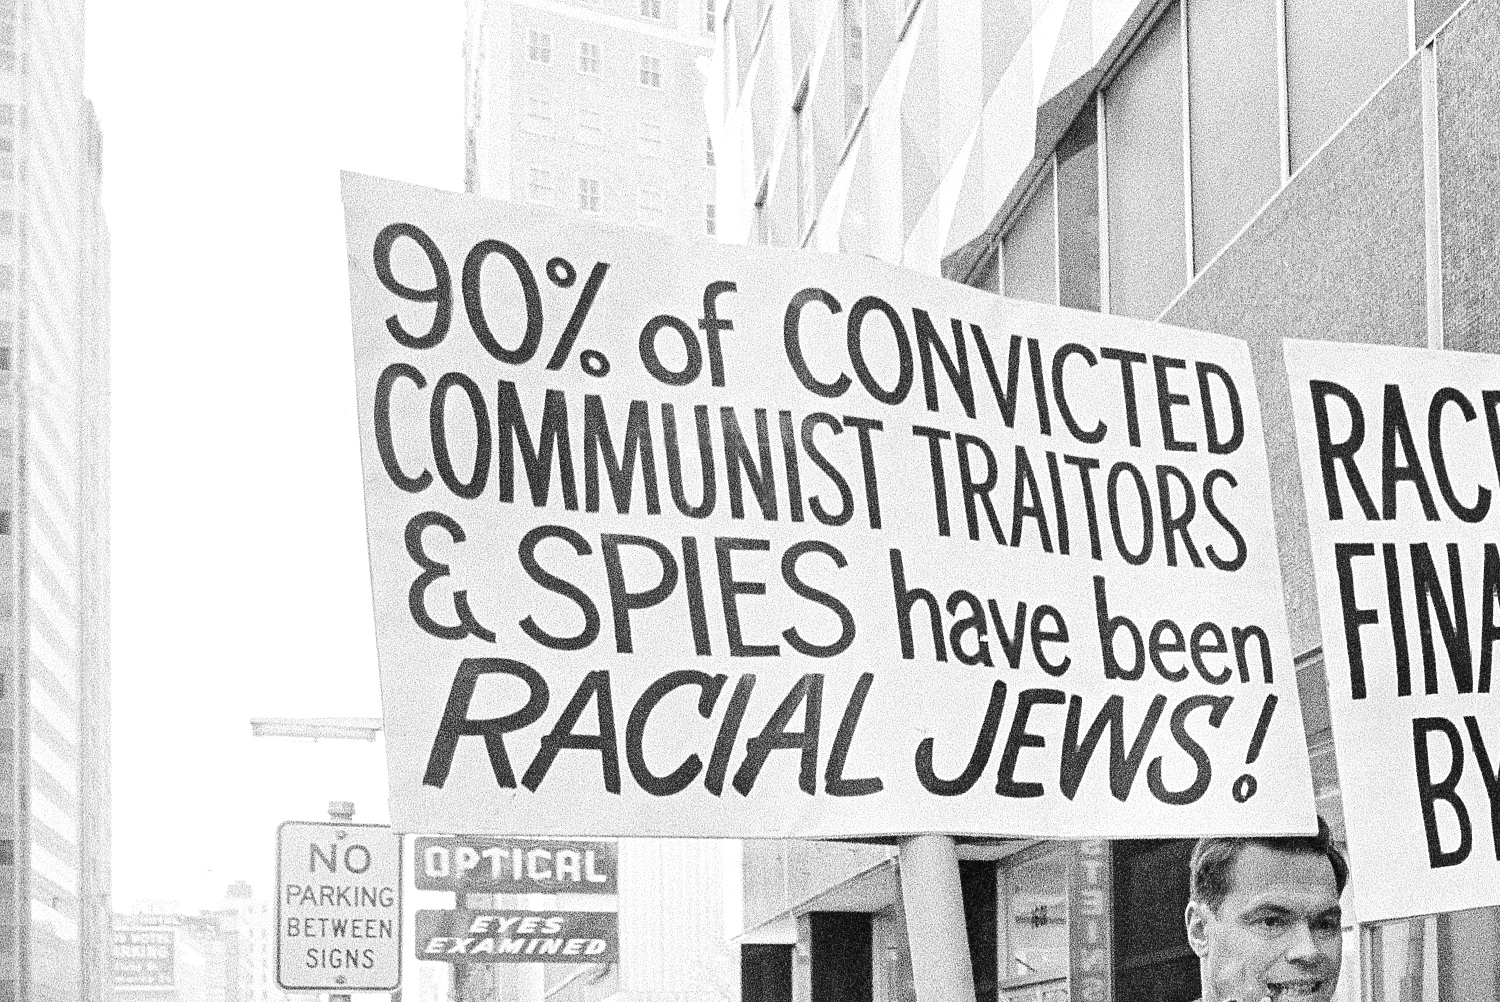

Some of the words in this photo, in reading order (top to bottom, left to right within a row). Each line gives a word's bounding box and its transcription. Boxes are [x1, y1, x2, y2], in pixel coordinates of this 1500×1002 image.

[372, 222, 610, 378] 90%
[638, 280, 737, 388] of
[783, 287, 1246, 455] CONVICTED
[373, 362, 884, 530] COMMUNIST
[911, 424, 1248, 573] TRAITORS
[403, 510, 497, 644] &
[517, 524, 856, 659] SPIES
[888, 547, 1072, 678] have
[1092, 574, 1275, 685] been
[422, 656, 884, 800] RACIAL
[914, 679, 1279, 806] JEWS!
[308, 843, 372, 875] NO
[424, 846, 607, 883] OPTICAL
[286, 884, 394, 908] PARKING
[287, 917, 393, 939] BETWEEN
[469, 915, 565, 934] EYES
[306, 948, 375, 969] SIGNS
[425, 936, 607, 955] EXAMINED
